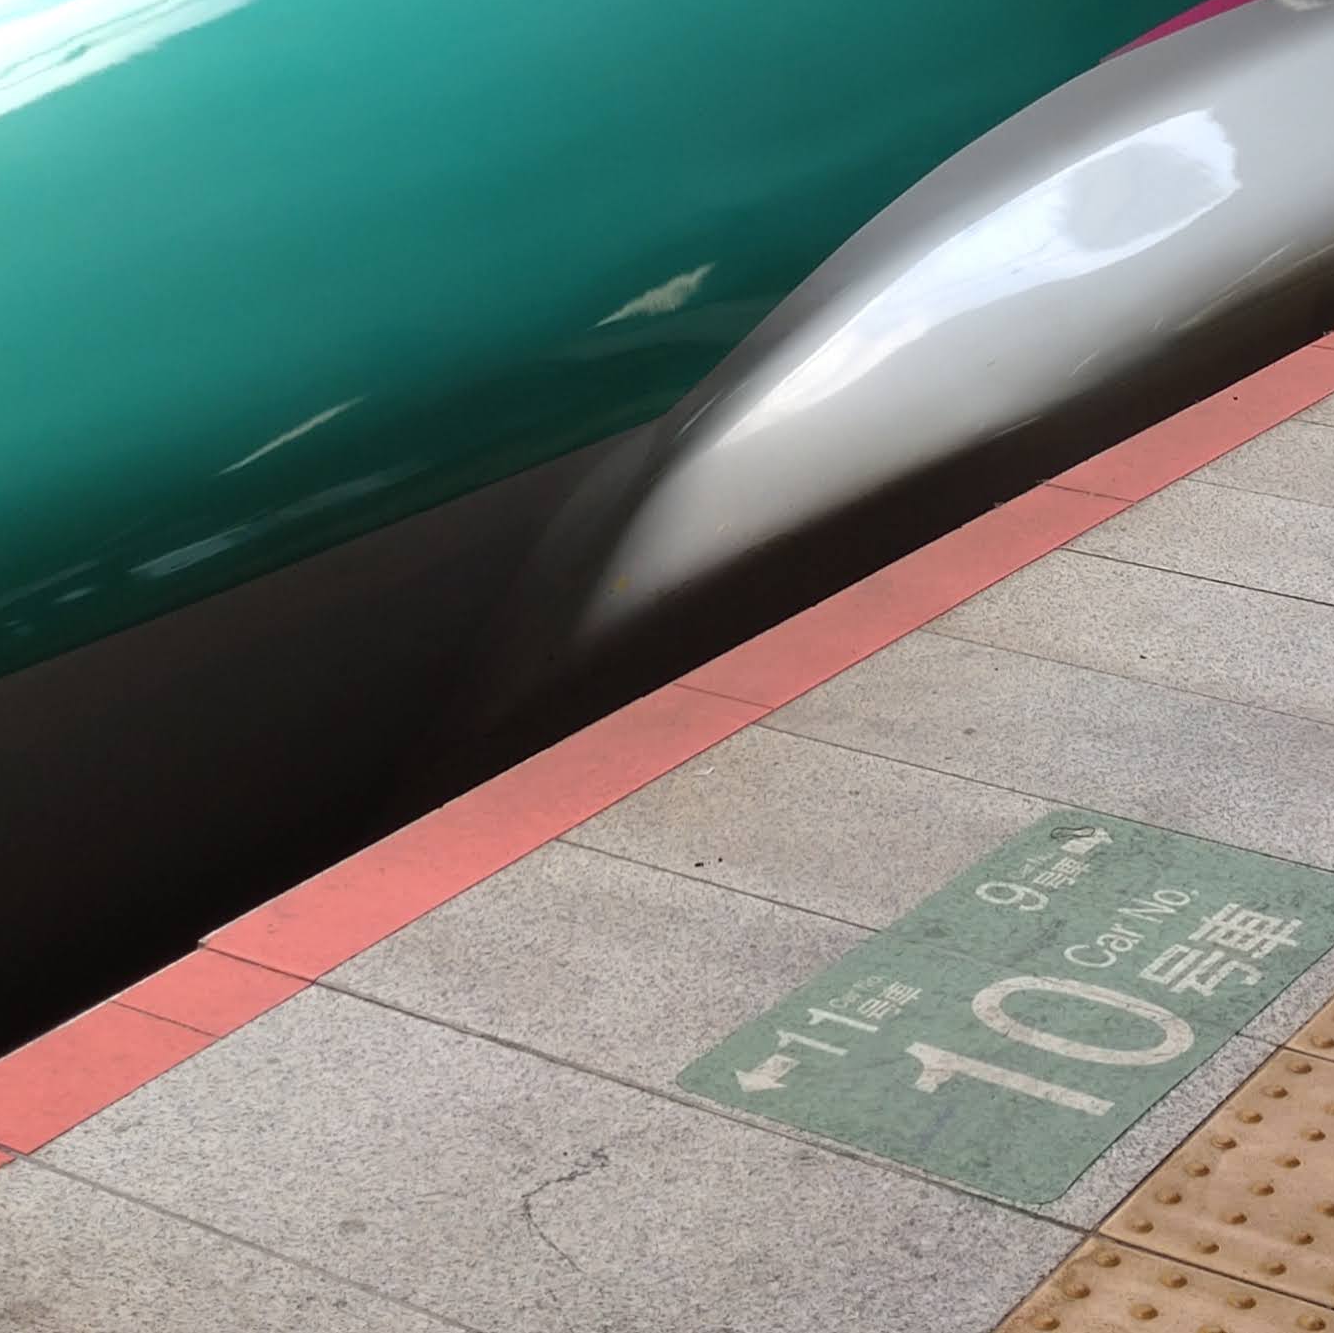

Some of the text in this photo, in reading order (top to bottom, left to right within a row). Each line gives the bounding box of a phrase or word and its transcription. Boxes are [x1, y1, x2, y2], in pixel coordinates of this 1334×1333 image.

[975, 881, 1049, 911] 9
[1064, 922, 1148, 968] Car
[776, 1007, 879, 1057] 11
[905, 902, 1303, 1117] 10 号車
